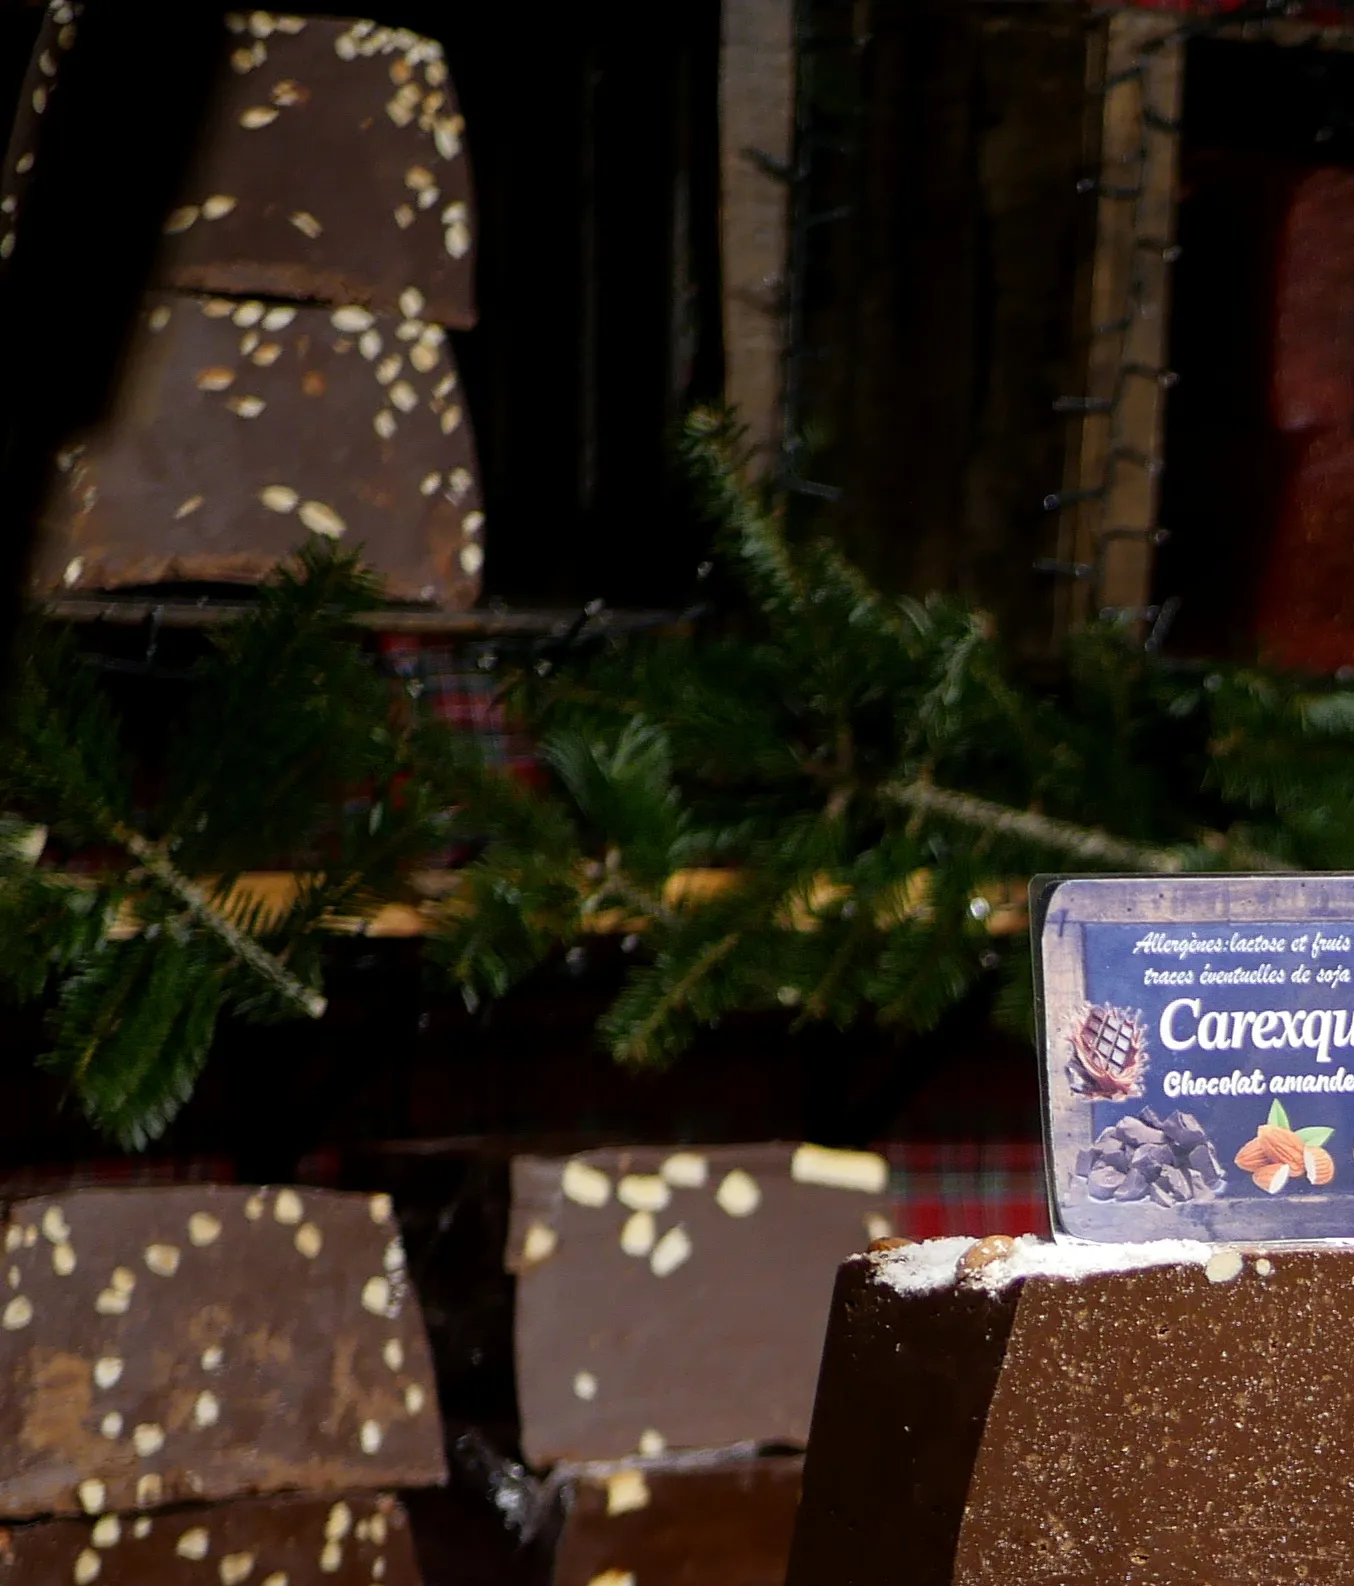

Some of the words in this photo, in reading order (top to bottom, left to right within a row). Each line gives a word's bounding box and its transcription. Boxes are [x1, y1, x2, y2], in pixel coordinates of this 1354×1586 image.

[1291, 934, 1308, 952] et
[1311, 931, 1350, 958] fruis
[1144, 967, 1194, 986] traces
[1200, 963, 1285, 985] éventuelles
[1291, 964, 1311, 983] de
[1316, 964, 1350, 988] soja
[1163, 1069, 1266, 1098] Chocolat
